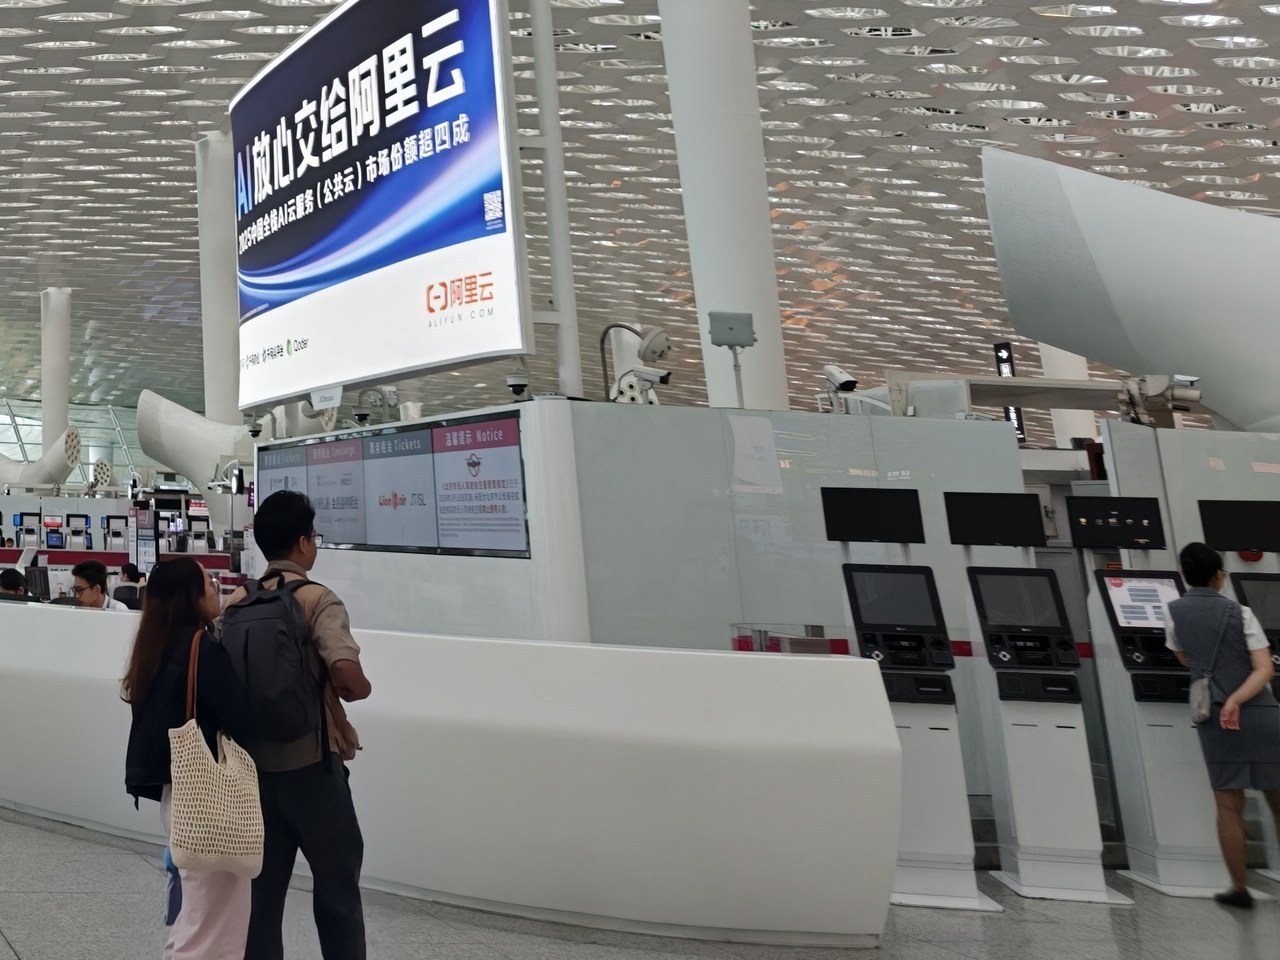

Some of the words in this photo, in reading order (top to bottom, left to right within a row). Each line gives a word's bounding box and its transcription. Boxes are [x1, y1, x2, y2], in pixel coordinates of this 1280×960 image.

[237, 8, 466, 222] AI放心交给阿里云
[450, 272, 494, 307] 阿里云
[394, 438, 421, 451] Tickets
[476, 428, 503, 442] Notice
